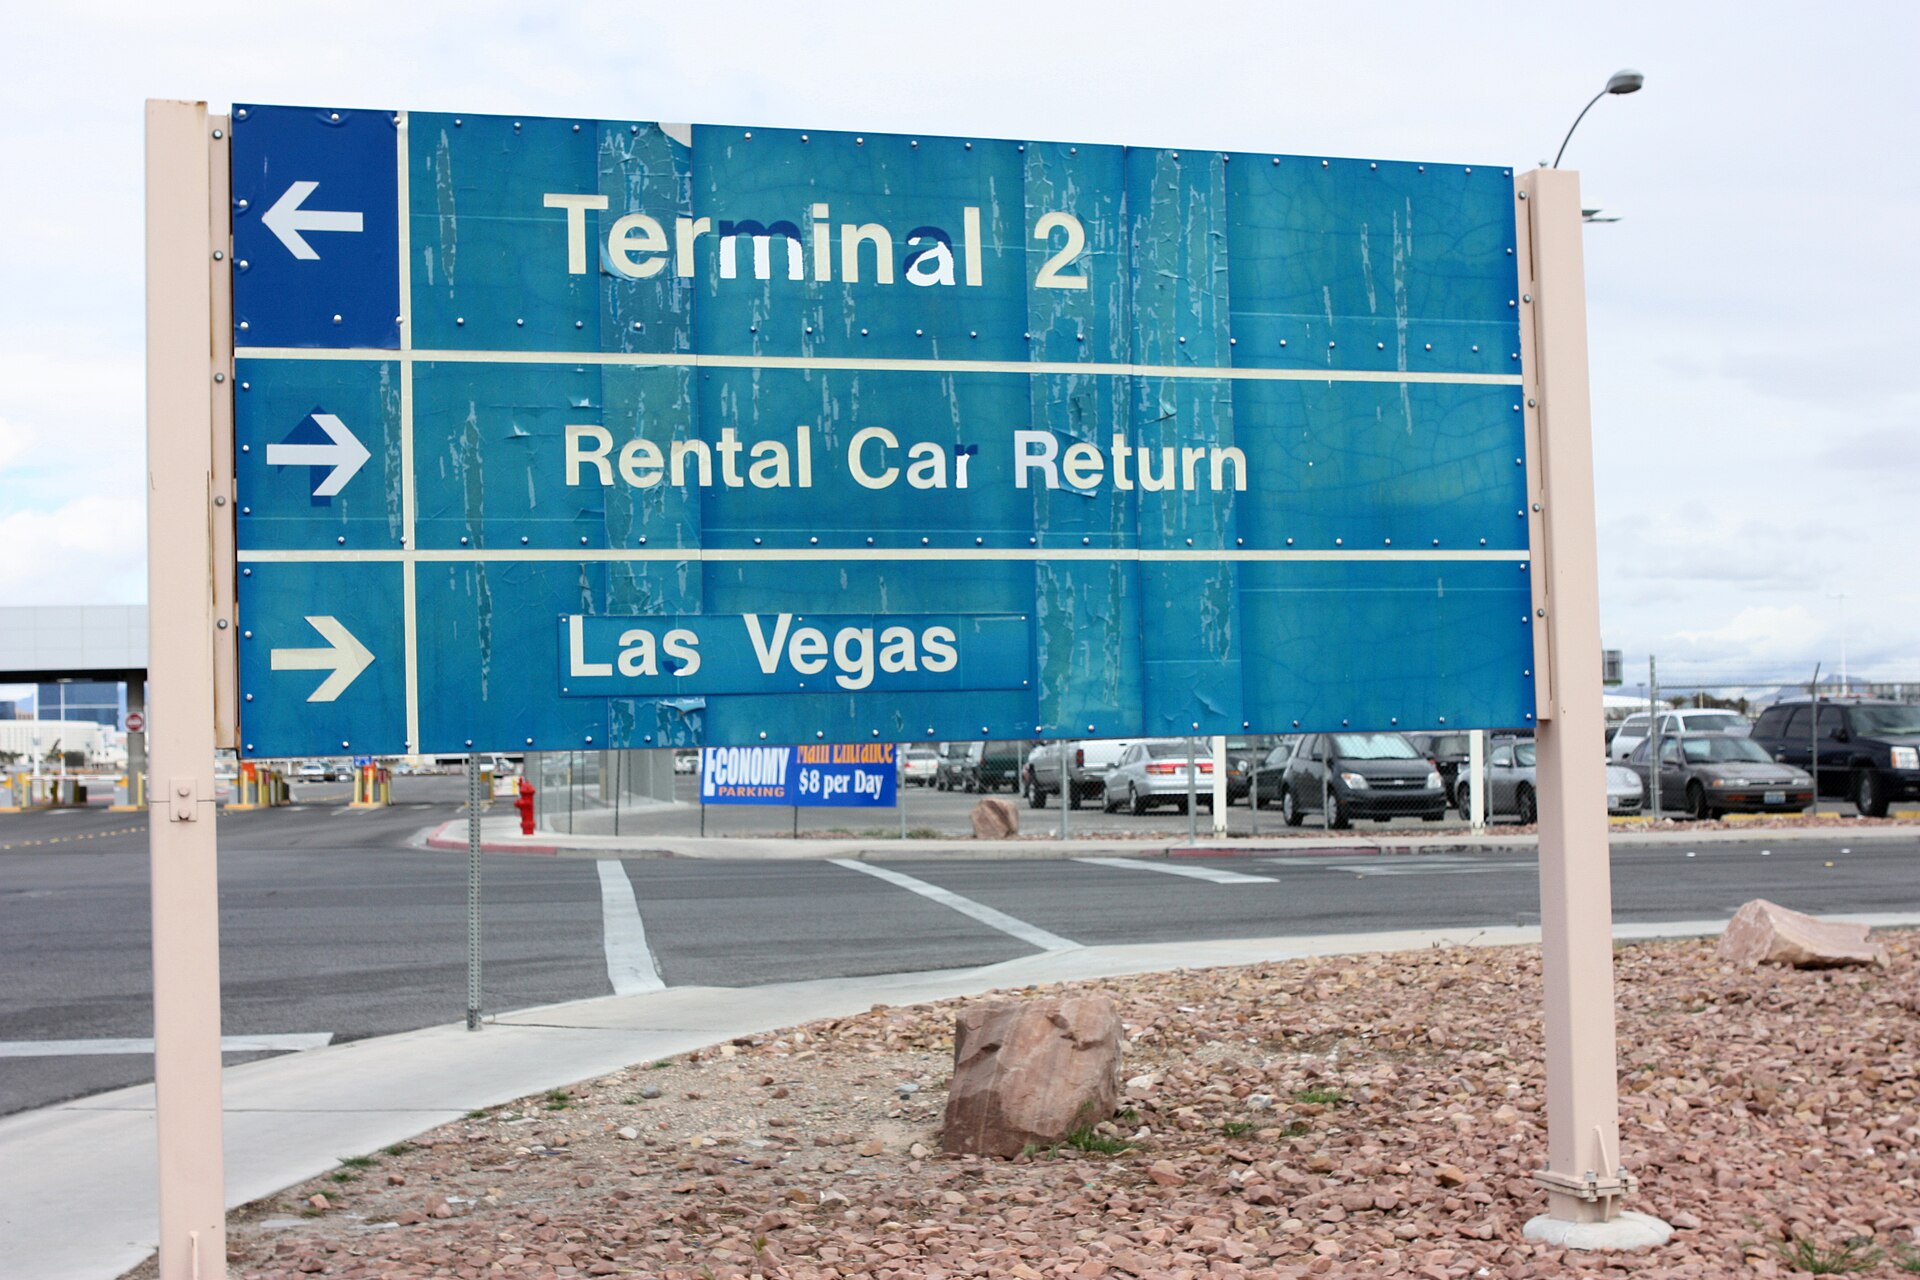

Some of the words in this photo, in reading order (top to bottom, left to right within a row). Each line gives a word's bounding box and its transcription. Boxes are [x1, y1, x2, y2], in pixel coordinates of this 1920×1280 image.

[543, 193, 983, 288] Terminal
[1033, 211, 1089, 291] 2
[564, 424, 813, 489] Rental
[847, 426, 979, 490] Car
[1013, 429, 1248, 493] Return
[568, 614, 701, 678] Las
[743, 612, 959, 691] Vegas
[703, 746, 791, 797] ECONOMY
[718, 785, 785, 798] PARKING
[798, 767, 820, 795] $8
[823, 774, 851, 800] per
[853, 769, 884, 801] Day
